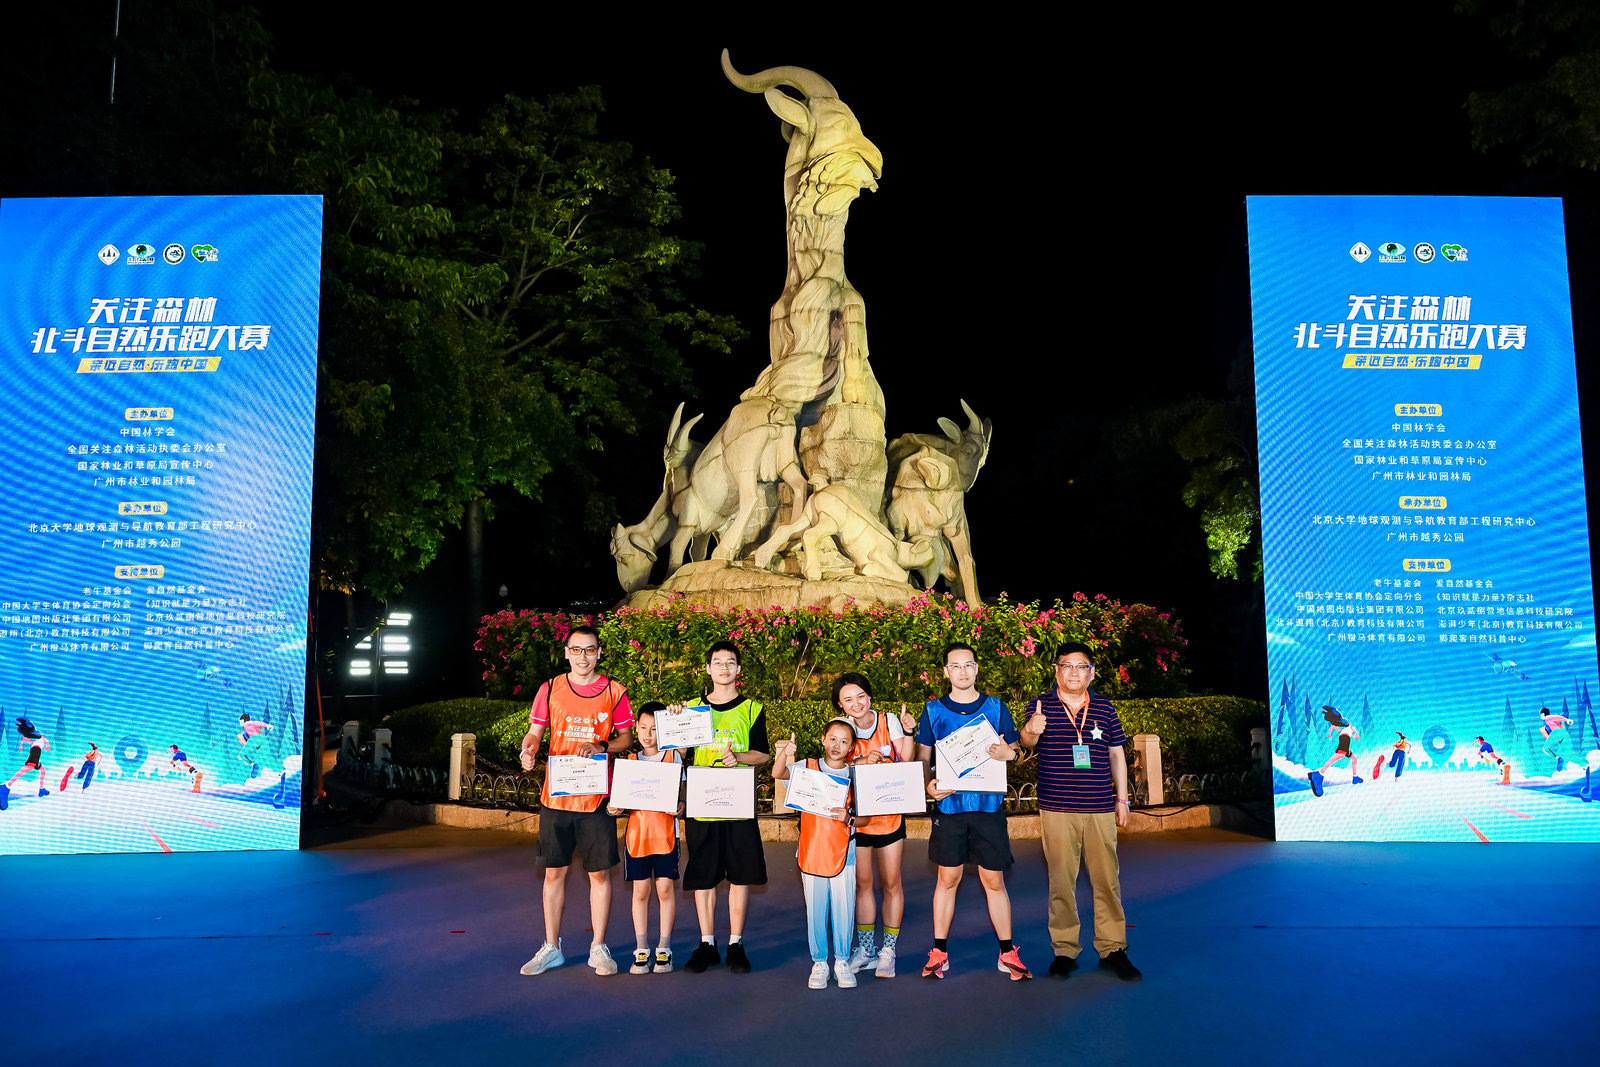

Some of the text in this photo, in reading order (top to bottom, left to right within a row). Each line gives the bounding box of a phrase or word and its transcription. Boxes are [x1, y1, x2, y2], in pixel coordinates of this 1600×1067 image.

[86, 296, 217, 324] 关注森林
[1346, 294, 1472, 321] 关注森林
[30, 324, 271, 354] 北斗自然乐跑大赛
[1293, 322, 1527, 350] 北斗自然乐跑大赛
[129, 409, 169, 419] 主办单位
[1399, 405, 1438, 415] 主办单位
[120, 426, 176, 437] 中国林学会
[1391, 422, 1446, 433] 中国林学会
[67, 442, 227, 455] 全国关注森林活动执委会办公室
[1342, 438, 1497, 450] 全国关注森林活动执委会办公室
[77, 460, 214, 472] 国家林业和草原局宣传中心
[1354, 455, 1487, 466] 国家林业和草原局宣传中心
[93, 475, 196, 487] 广州市林业和园林局
[1372, 471, 1472, 482] 广州市林业和园林局
[123, 503, 163, 514] 承办单位
[1404, 498, 1443, 508] 承办单位
[1312, 514, 1536, 527] 北京大学地球观测与导航教育部工程研究中心
[28, 520, 258, 534] 北京大学地球观测与导航教育部工程研究中心
[1386, 532, 1465, 543] 广州市越秀公园
[101, 538, 182, 549] 广州市越秀公园
[1408, 560, 1446, 570] 支持单位
[120, 567, 159, 577] 支持单位
[1373, 578, 1422, 588] 老牛基金会
[1435, 578, 1494, 589] 爱自然基金会
[83, 585, 132, 596] 老牛基金会
[146, 584, 206, 595] 爱自然基金会
[1295, 591, 1423, 602] 中国大学生体育协会定向分会
[1436, 592, 1534, 603] 《知识就是力量》杂志社
[2, 599, 131, 611] 中国大学生体育协会定向分会
[1296, 604, 1424, 615] 中国地图出版社集团有限公司
